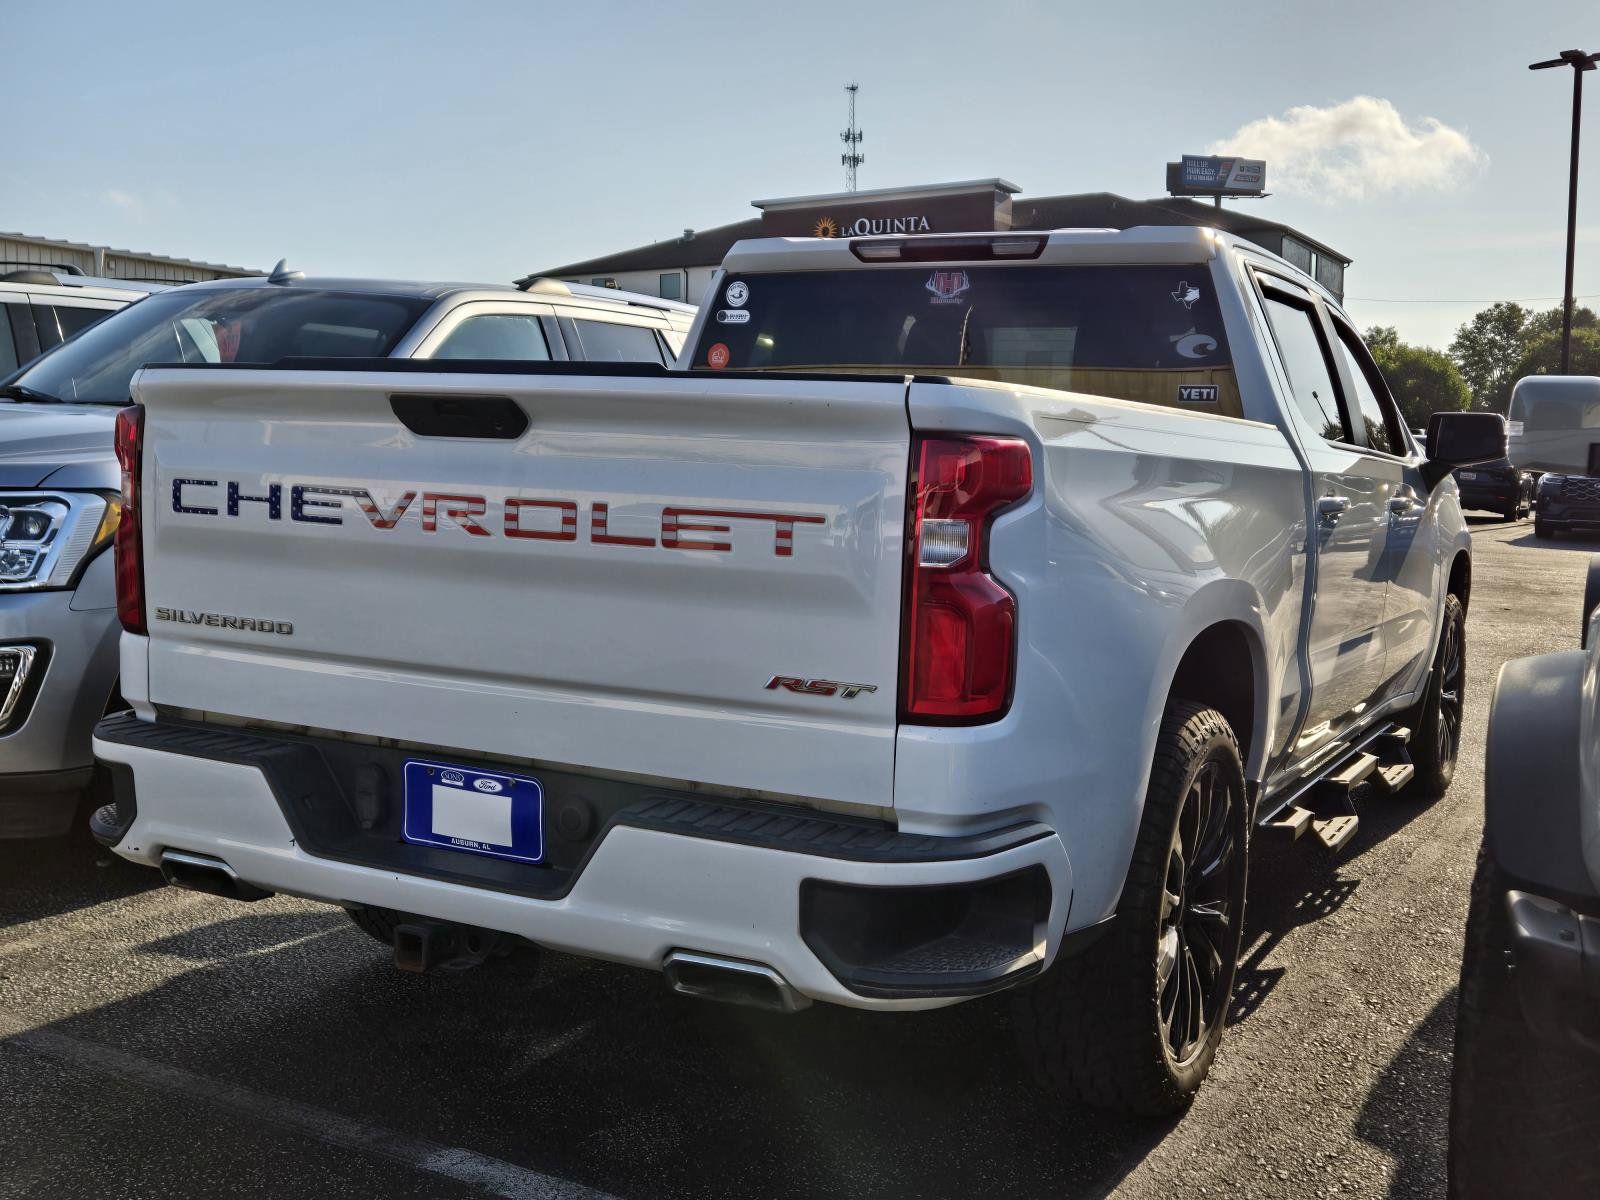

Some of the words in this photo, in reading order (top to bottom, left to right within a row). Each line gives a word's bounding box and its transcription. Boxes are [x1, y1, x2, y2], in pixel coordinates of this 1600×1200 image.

[841, 227, 855, 236] LA
[854, 215, 930, 236] QUINTA
[1181, 388, 1215, 400] YETI
[171, 478, 826, 557] CHEVROLET
[155, 607, 293, 635] SILVERADO
[764, 674, 878, 699] RST
[478, 780, 498, 791] Ford
[451, 838, 481, 850] AUBURN,
